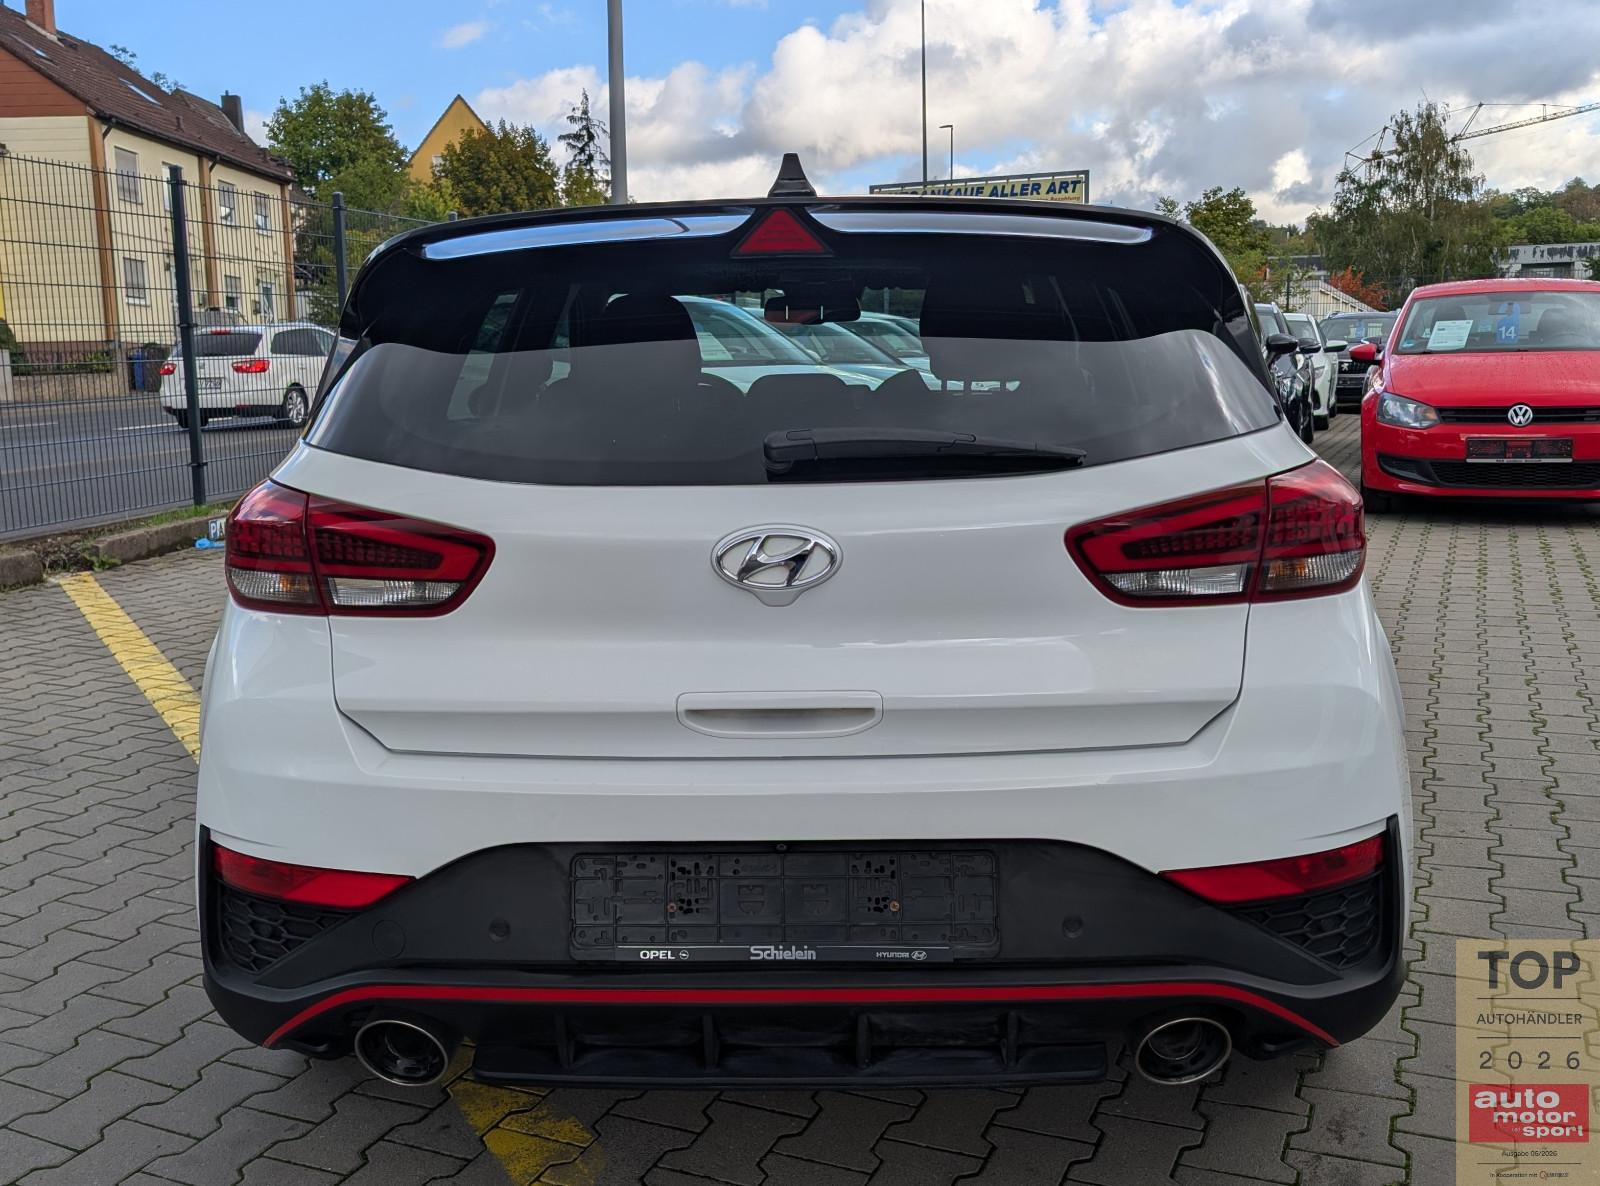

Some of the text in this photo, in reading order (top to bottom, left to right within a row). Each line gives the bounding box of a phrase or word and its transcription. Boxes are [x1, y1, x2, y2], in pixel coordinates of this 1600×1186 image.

[988, 183, 1042, 198] ALLER
[1045, 180, 1082, 194] ART
[1499, 326, 1517, 339] 14
[640, 945, 909, 960] OPEL Schielein HYUNDAI
